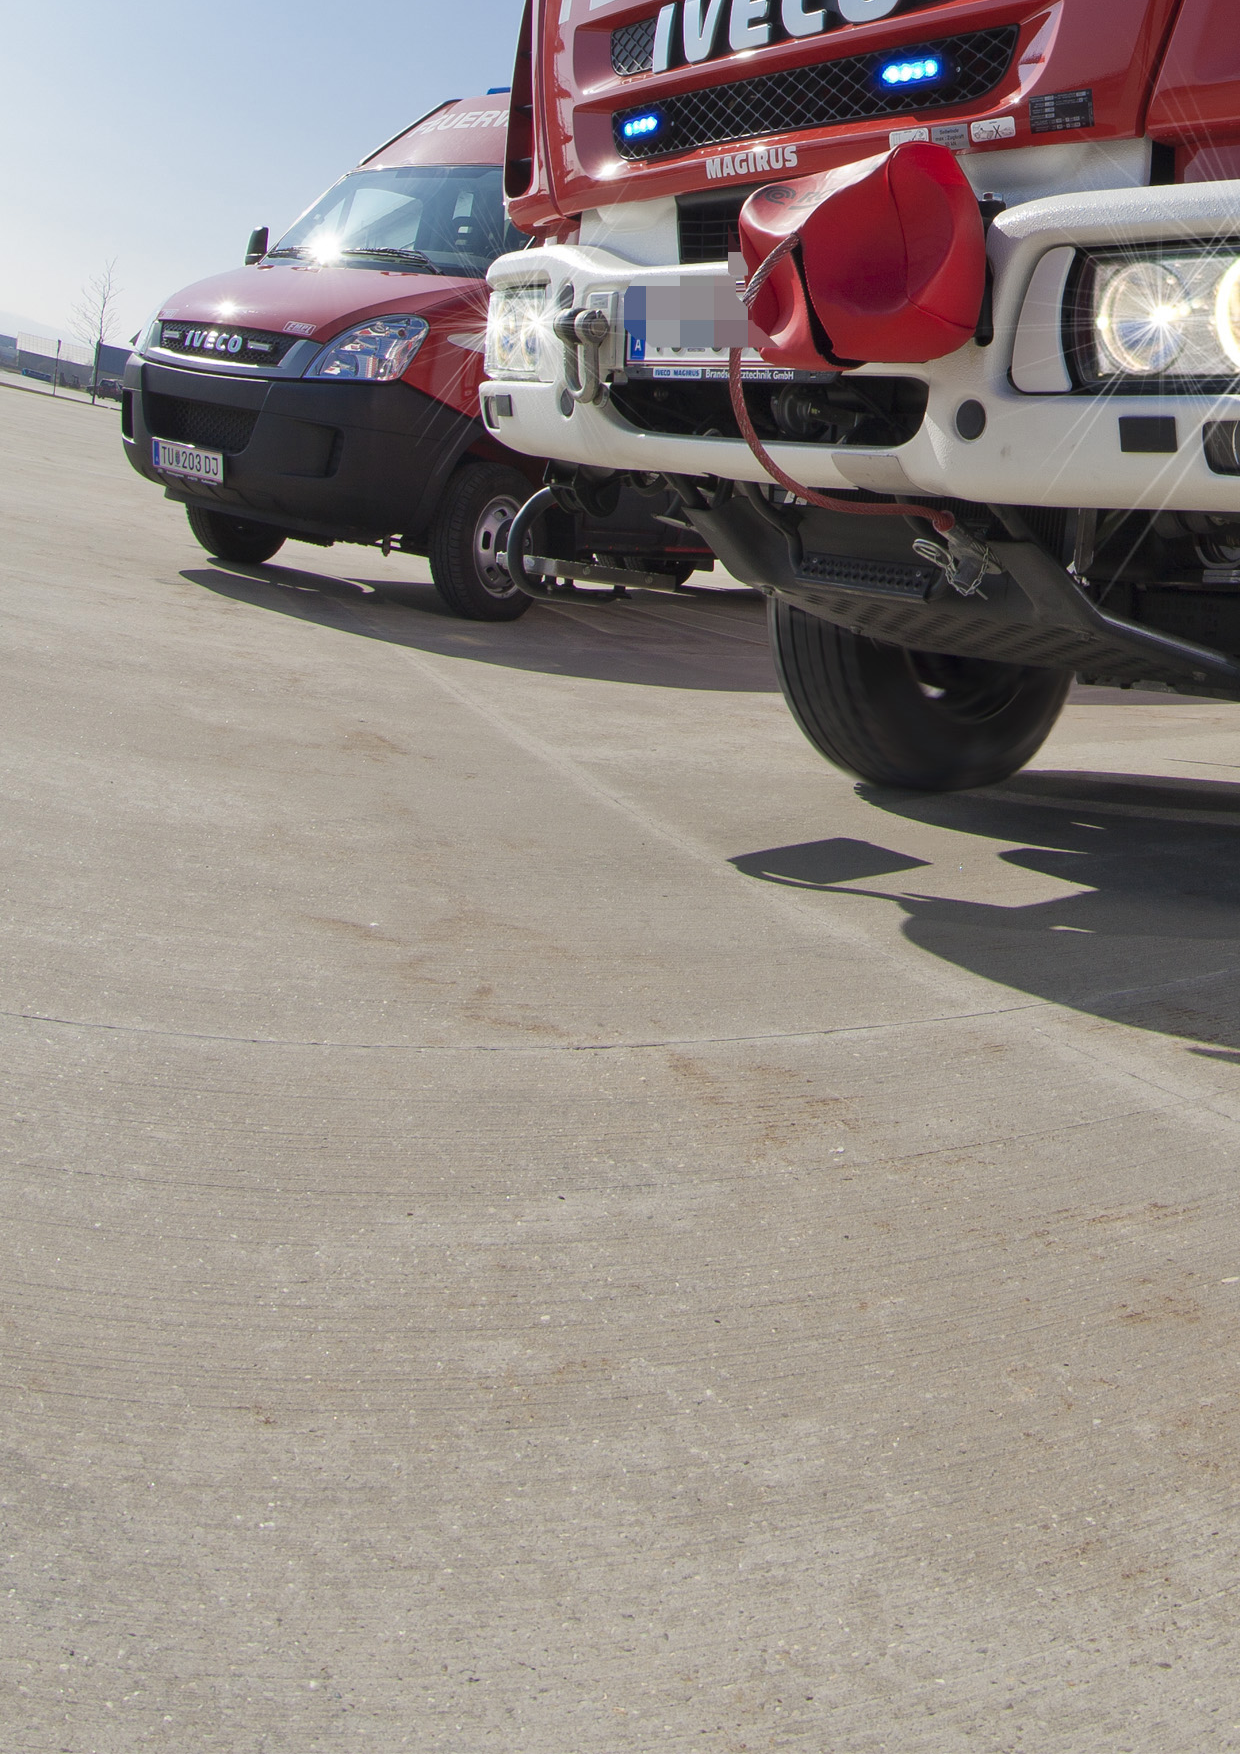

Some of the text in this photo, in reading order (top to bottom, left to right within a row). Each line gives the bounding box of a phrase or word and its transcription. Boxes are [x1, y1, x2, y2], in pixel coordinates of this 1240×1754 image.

[706, 145, 798, 180] MAGIRUS
[287, 322, 315, 335] EMPL
[184, 329, 243, 353] IVECO
[634, 339, 642, 351] A
[655, 369, 671, 377] IVECO
[673, 369, 700, 377] MAGIRUS
[773, 370, 795, 380] GmbH
[161, 446, 219, 476] TU 203 DJ
